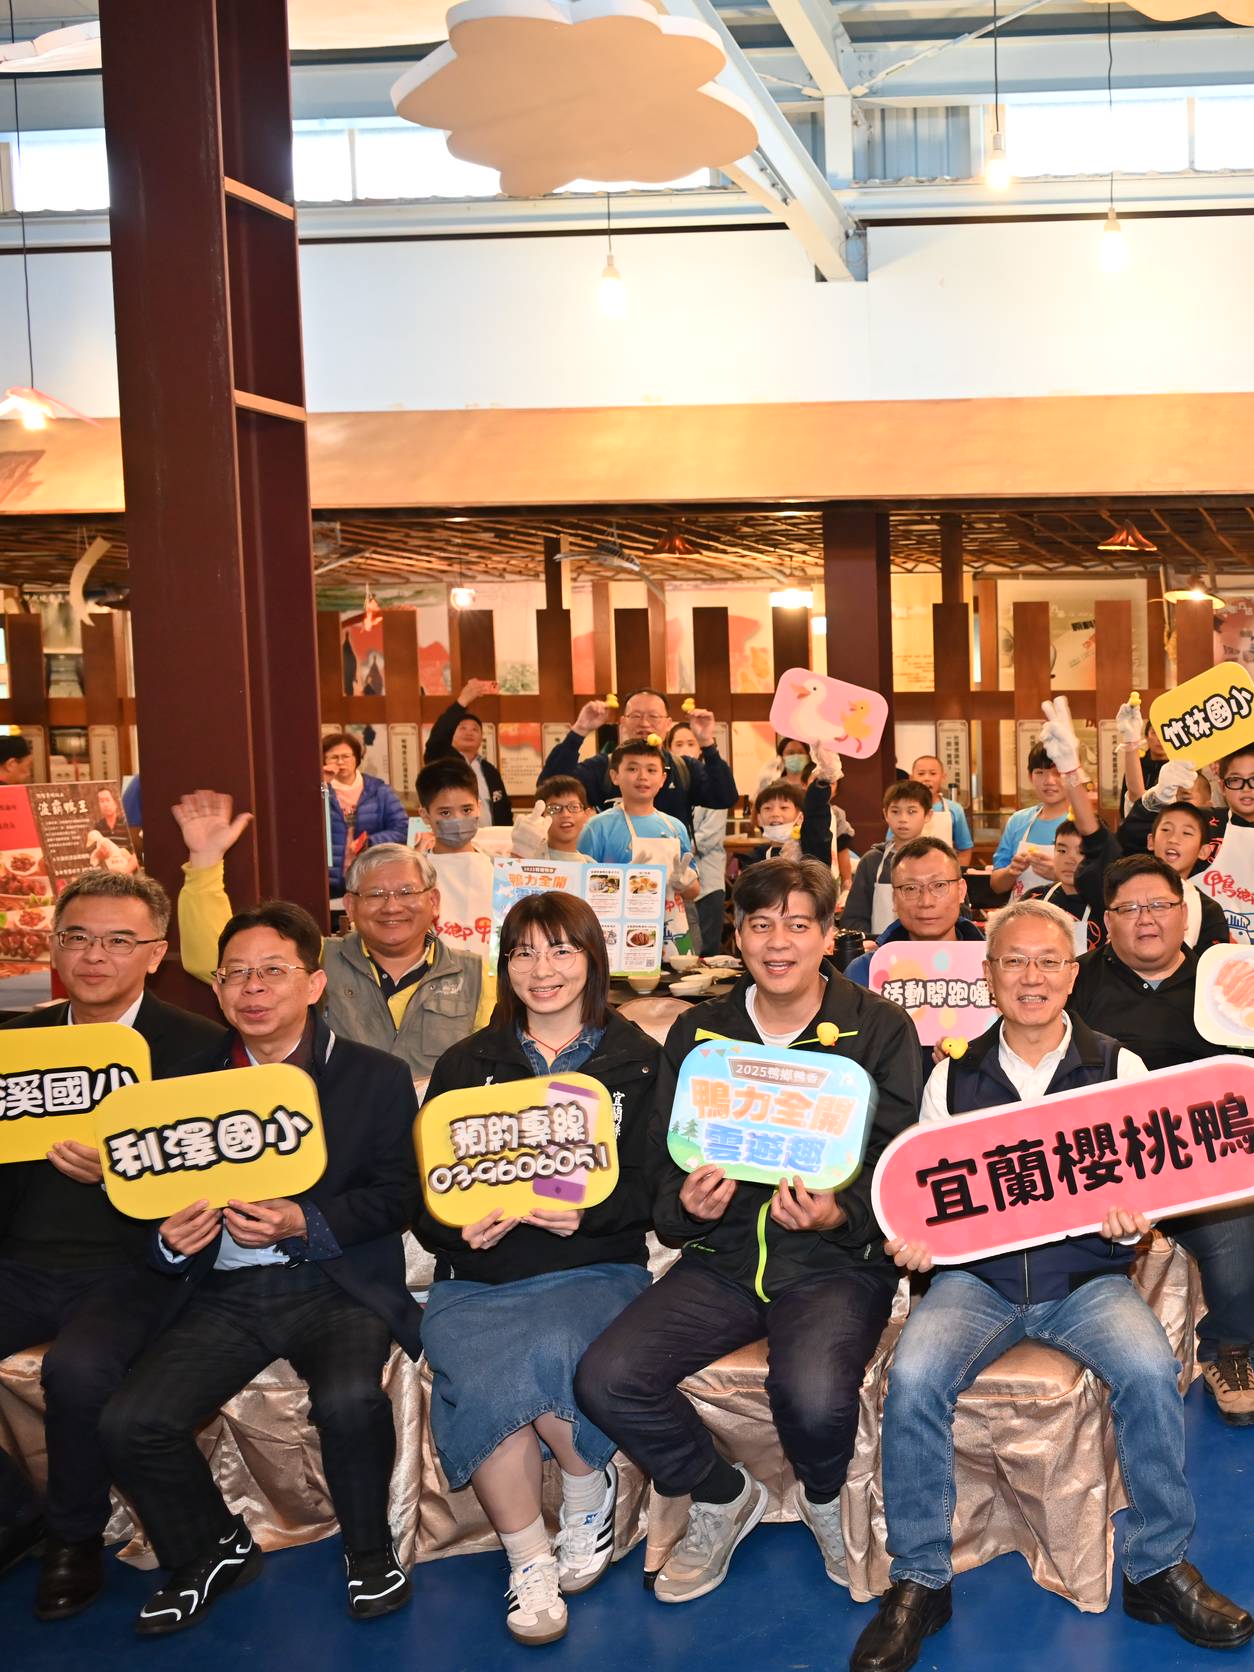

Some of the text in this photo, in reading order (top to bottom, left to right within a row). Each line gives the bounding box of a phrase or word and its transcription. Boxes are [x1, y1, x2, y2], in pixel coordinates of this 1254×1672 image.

[1162, 686, 1253, 749] 竹林國小
[883, 979, 997, 1008] 活動開跑囉
[451, 1104, 589, 1160] 預約專線
[689, 1077, 858, 1137] 鴨力全開
[107, 1107, 312, 1178] 利澤國小
[430, 1144, 609, 1193] 03-9606051
[704, 1121, 830, 1173] 雲遊趣
